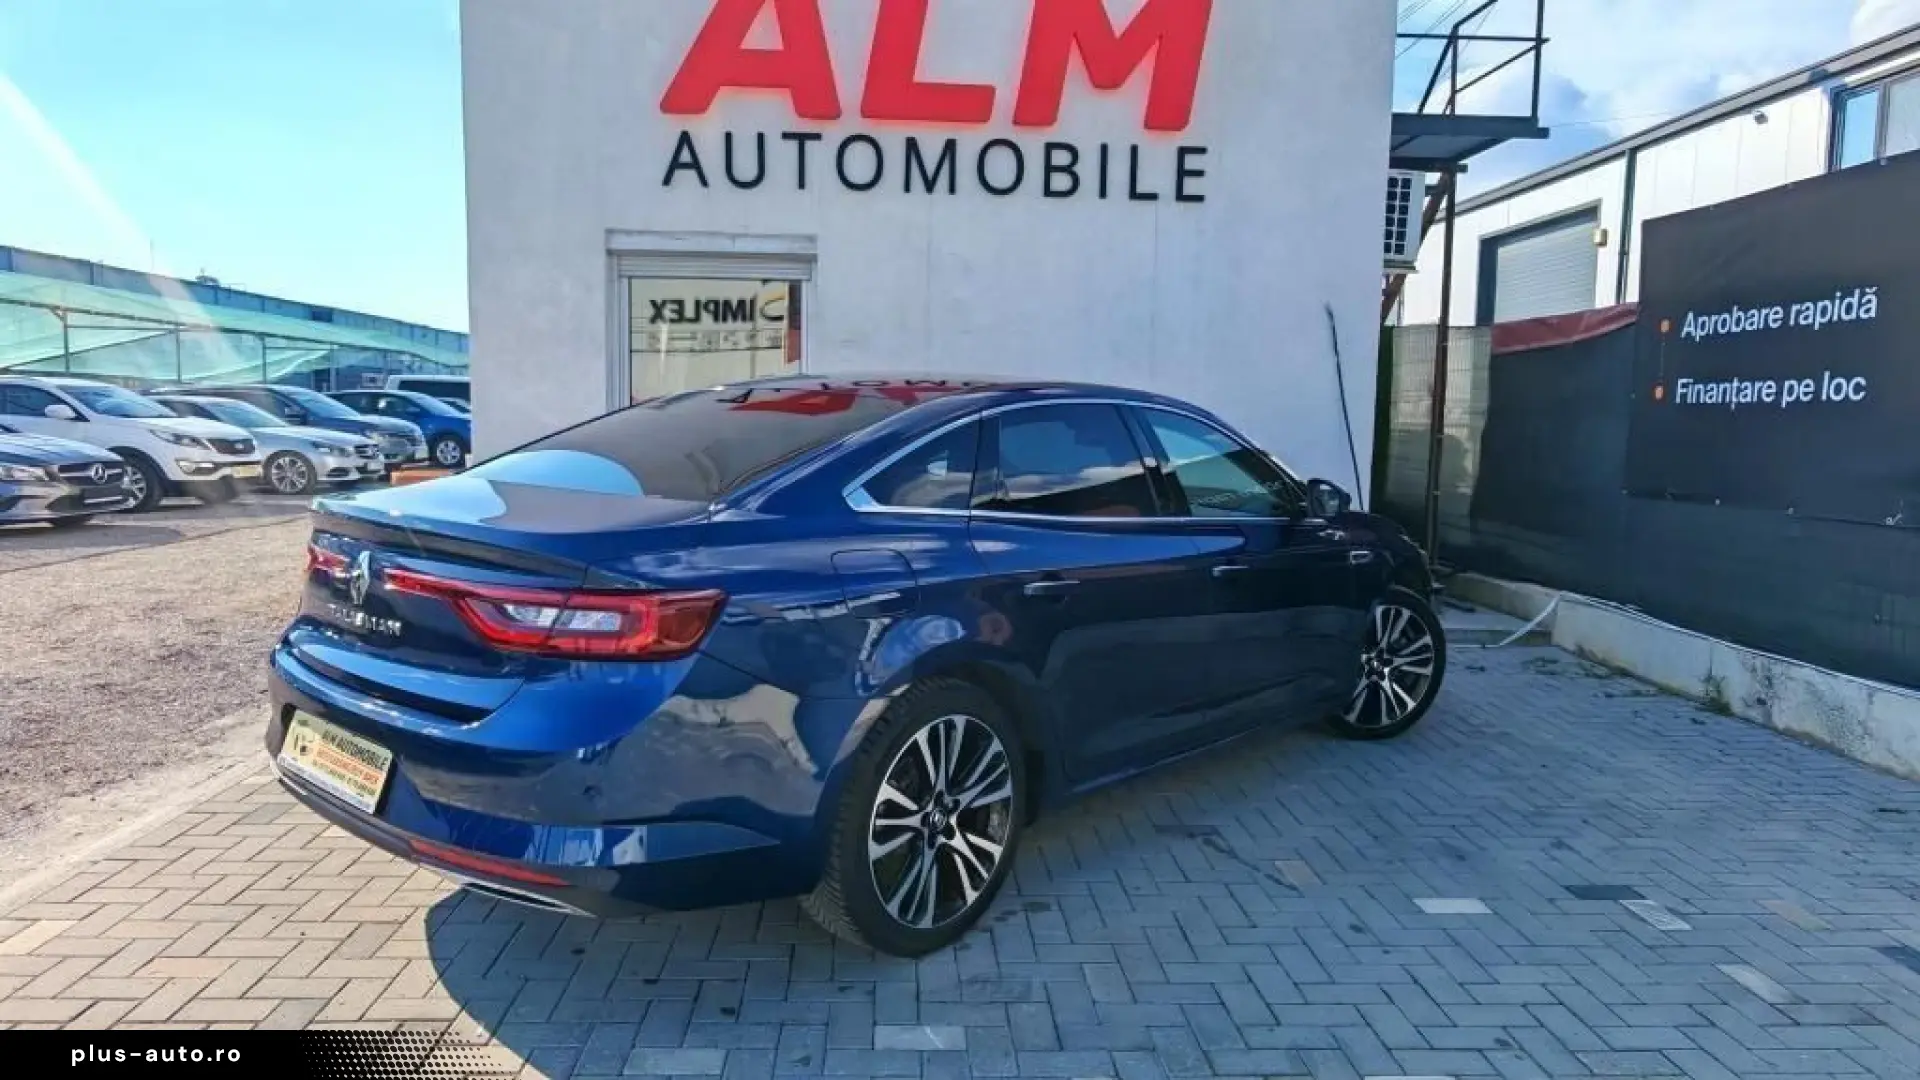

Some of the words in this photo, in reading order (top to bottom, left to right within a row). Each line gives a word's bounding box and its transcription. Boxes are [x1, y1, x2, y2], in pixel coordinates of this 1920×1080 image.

[660, 0, 1212, 131] ALM
[661, 130, 1209, 204] AUTOMOBILE
[1680, 303, 1784, 342] Aprobare
[1788, 285, 1879, 331] rapidă
[1674, 375, 1777, 411] Finanțare
[1780, 378, 1816, 408] pe
[1821, 370, 1867, 402] loc
